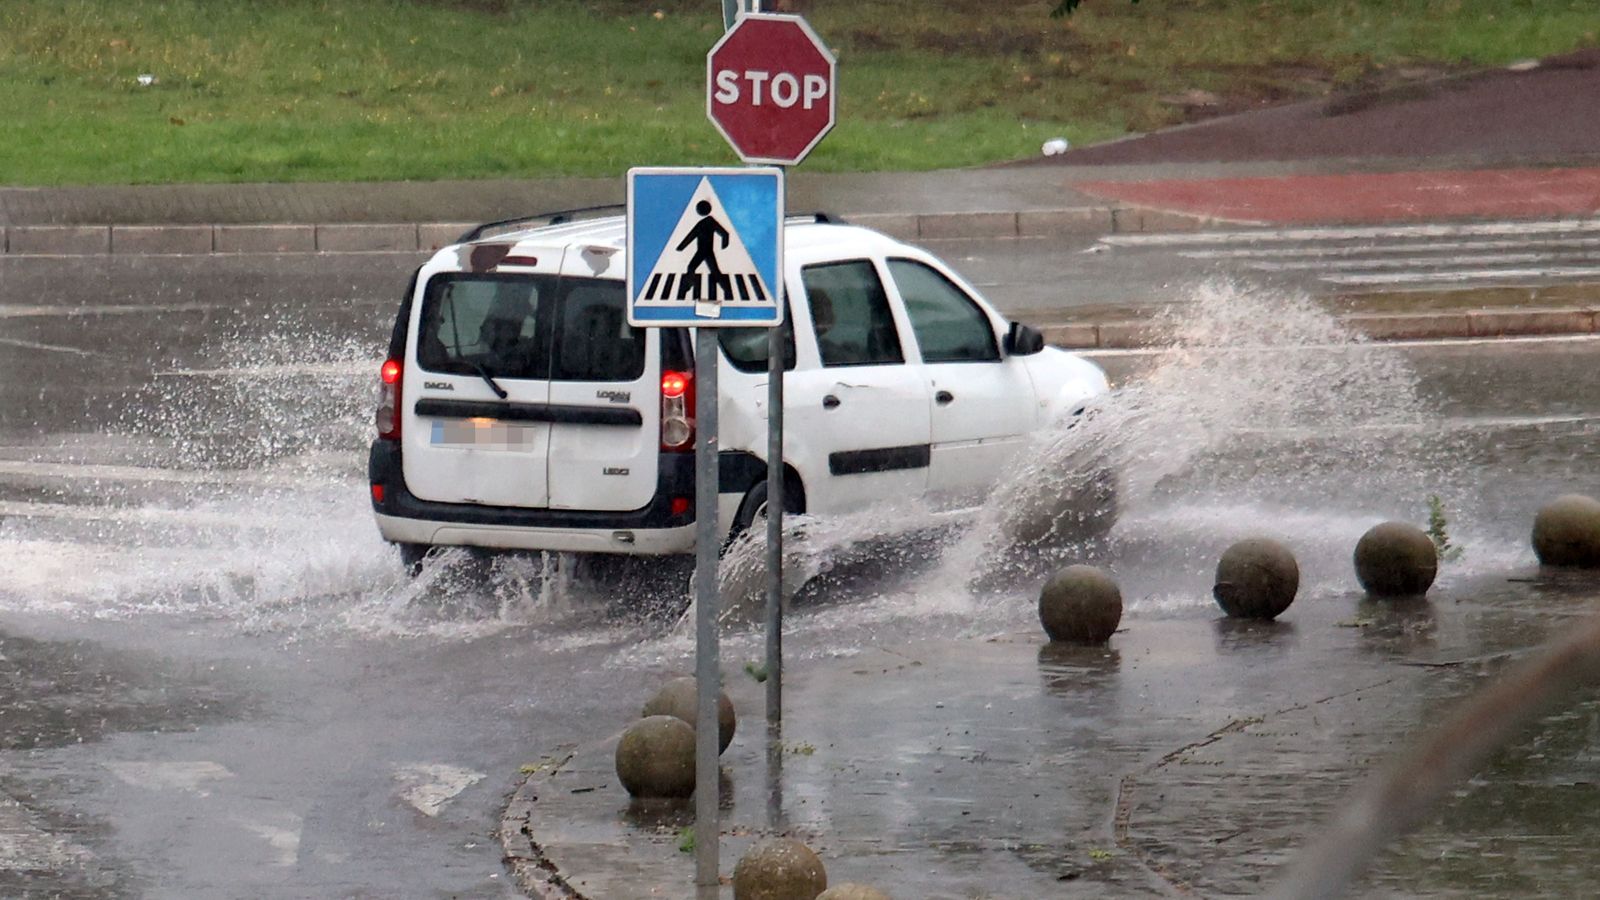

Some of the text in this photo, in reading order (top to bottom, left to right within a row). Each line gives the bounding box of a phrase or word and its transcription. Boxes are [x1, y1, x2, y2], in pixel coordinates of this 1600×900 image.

[715, 70, 827, 109] STOP
[424, 382, 454, 391] DACIA
[596, 390, 631, 400] LOGAN
